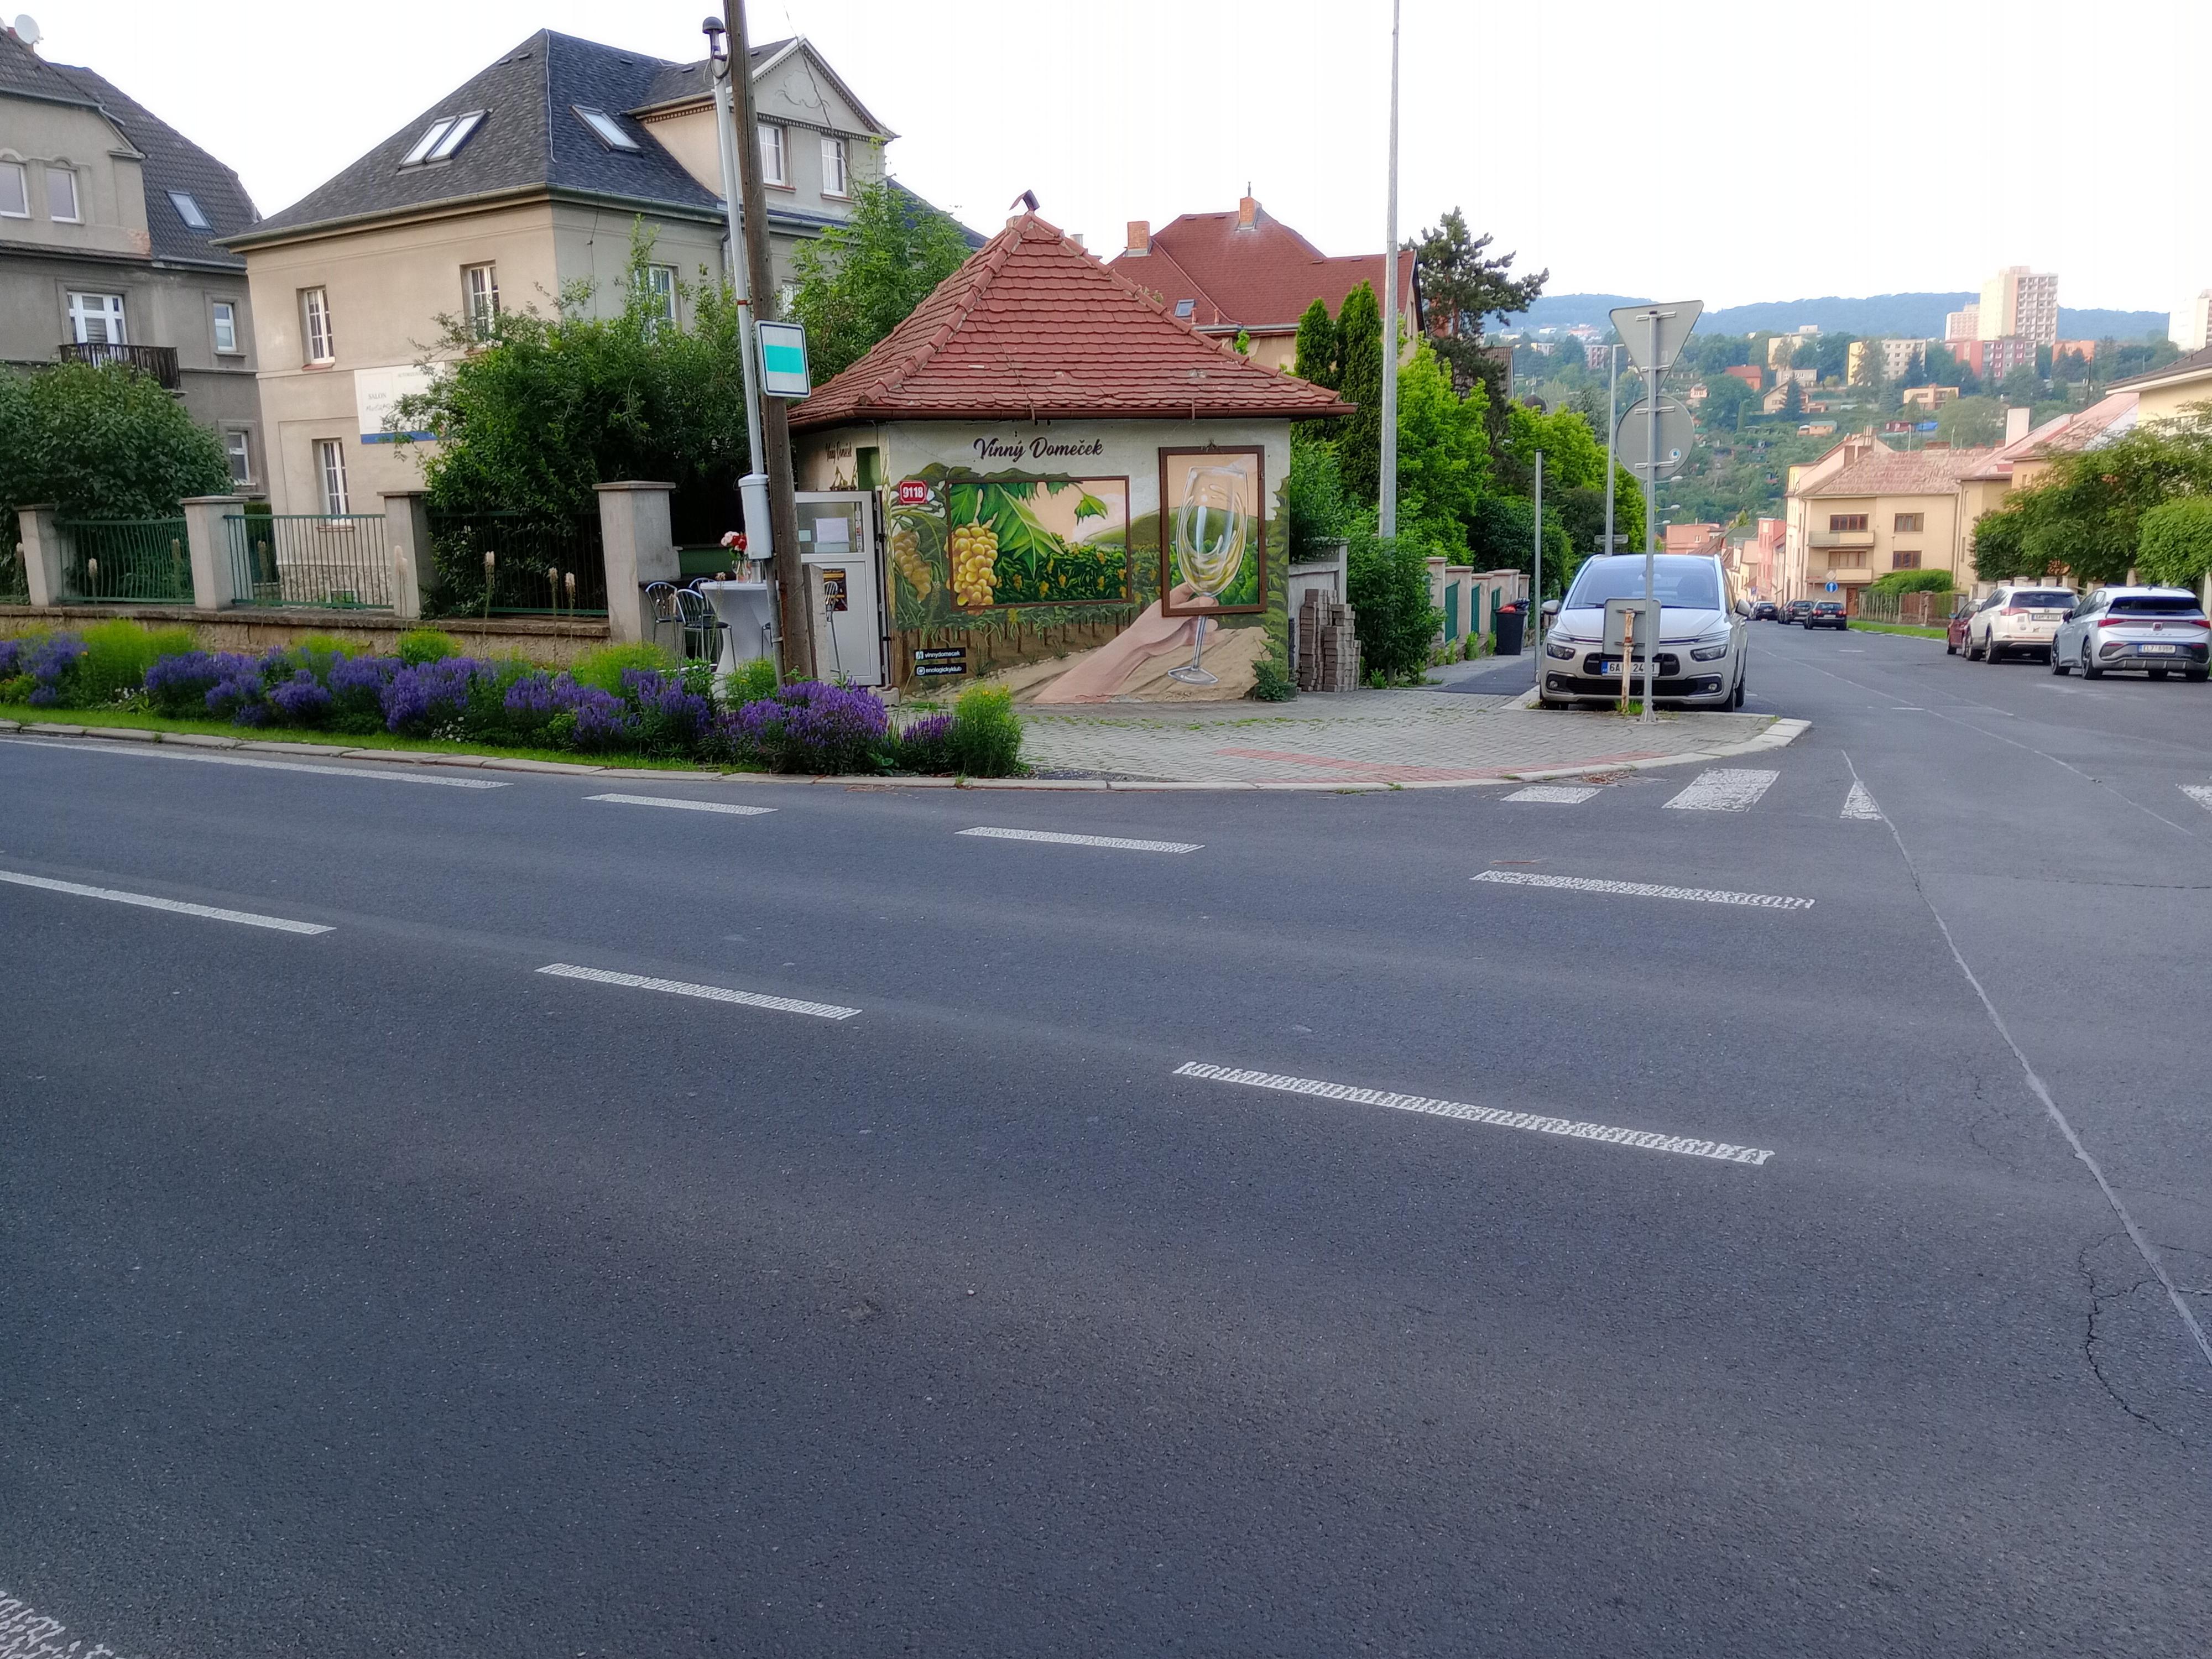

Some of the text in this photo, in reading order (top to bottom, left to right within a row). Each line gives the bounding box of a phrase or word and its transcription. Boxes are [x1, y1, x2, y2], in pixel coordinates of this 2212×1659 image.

[973, 437, 1104, 462] Vinný Domeček
[902, 486, 924, 498] 9118
[1633, 664, 1655, 672] 241
